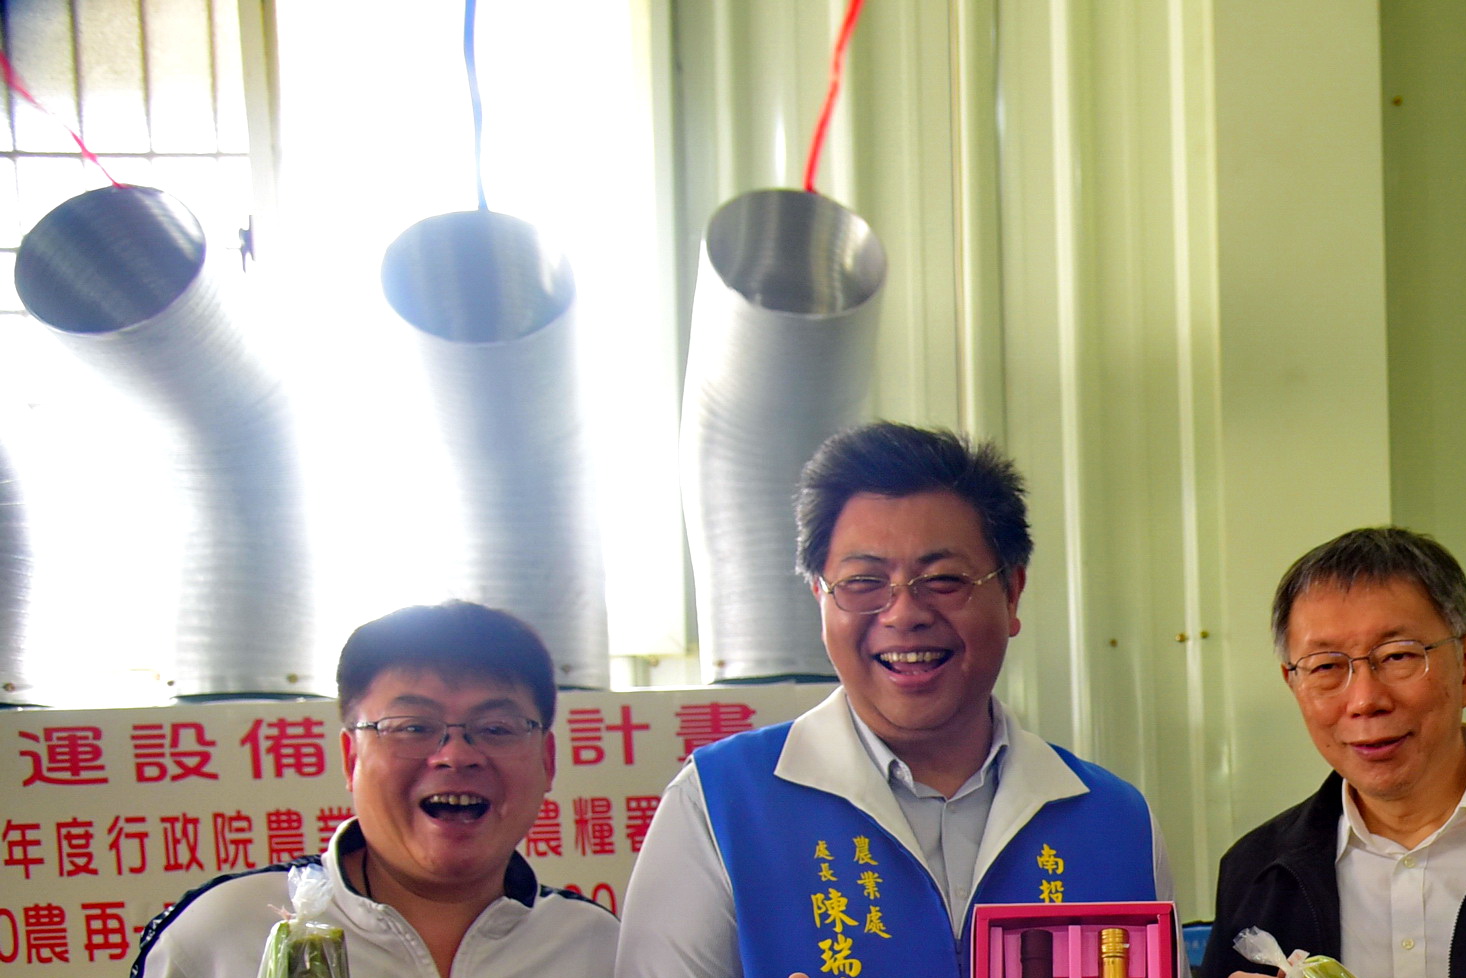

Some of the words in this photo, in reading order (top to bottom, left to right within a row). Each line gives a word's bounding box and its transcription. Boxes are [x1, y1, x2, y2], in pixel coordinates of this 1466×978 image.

[18, 717, 326, 787] 運設備
[813, 840, 838, 881] 處長
[852, 835, 892, 938] 農業處
